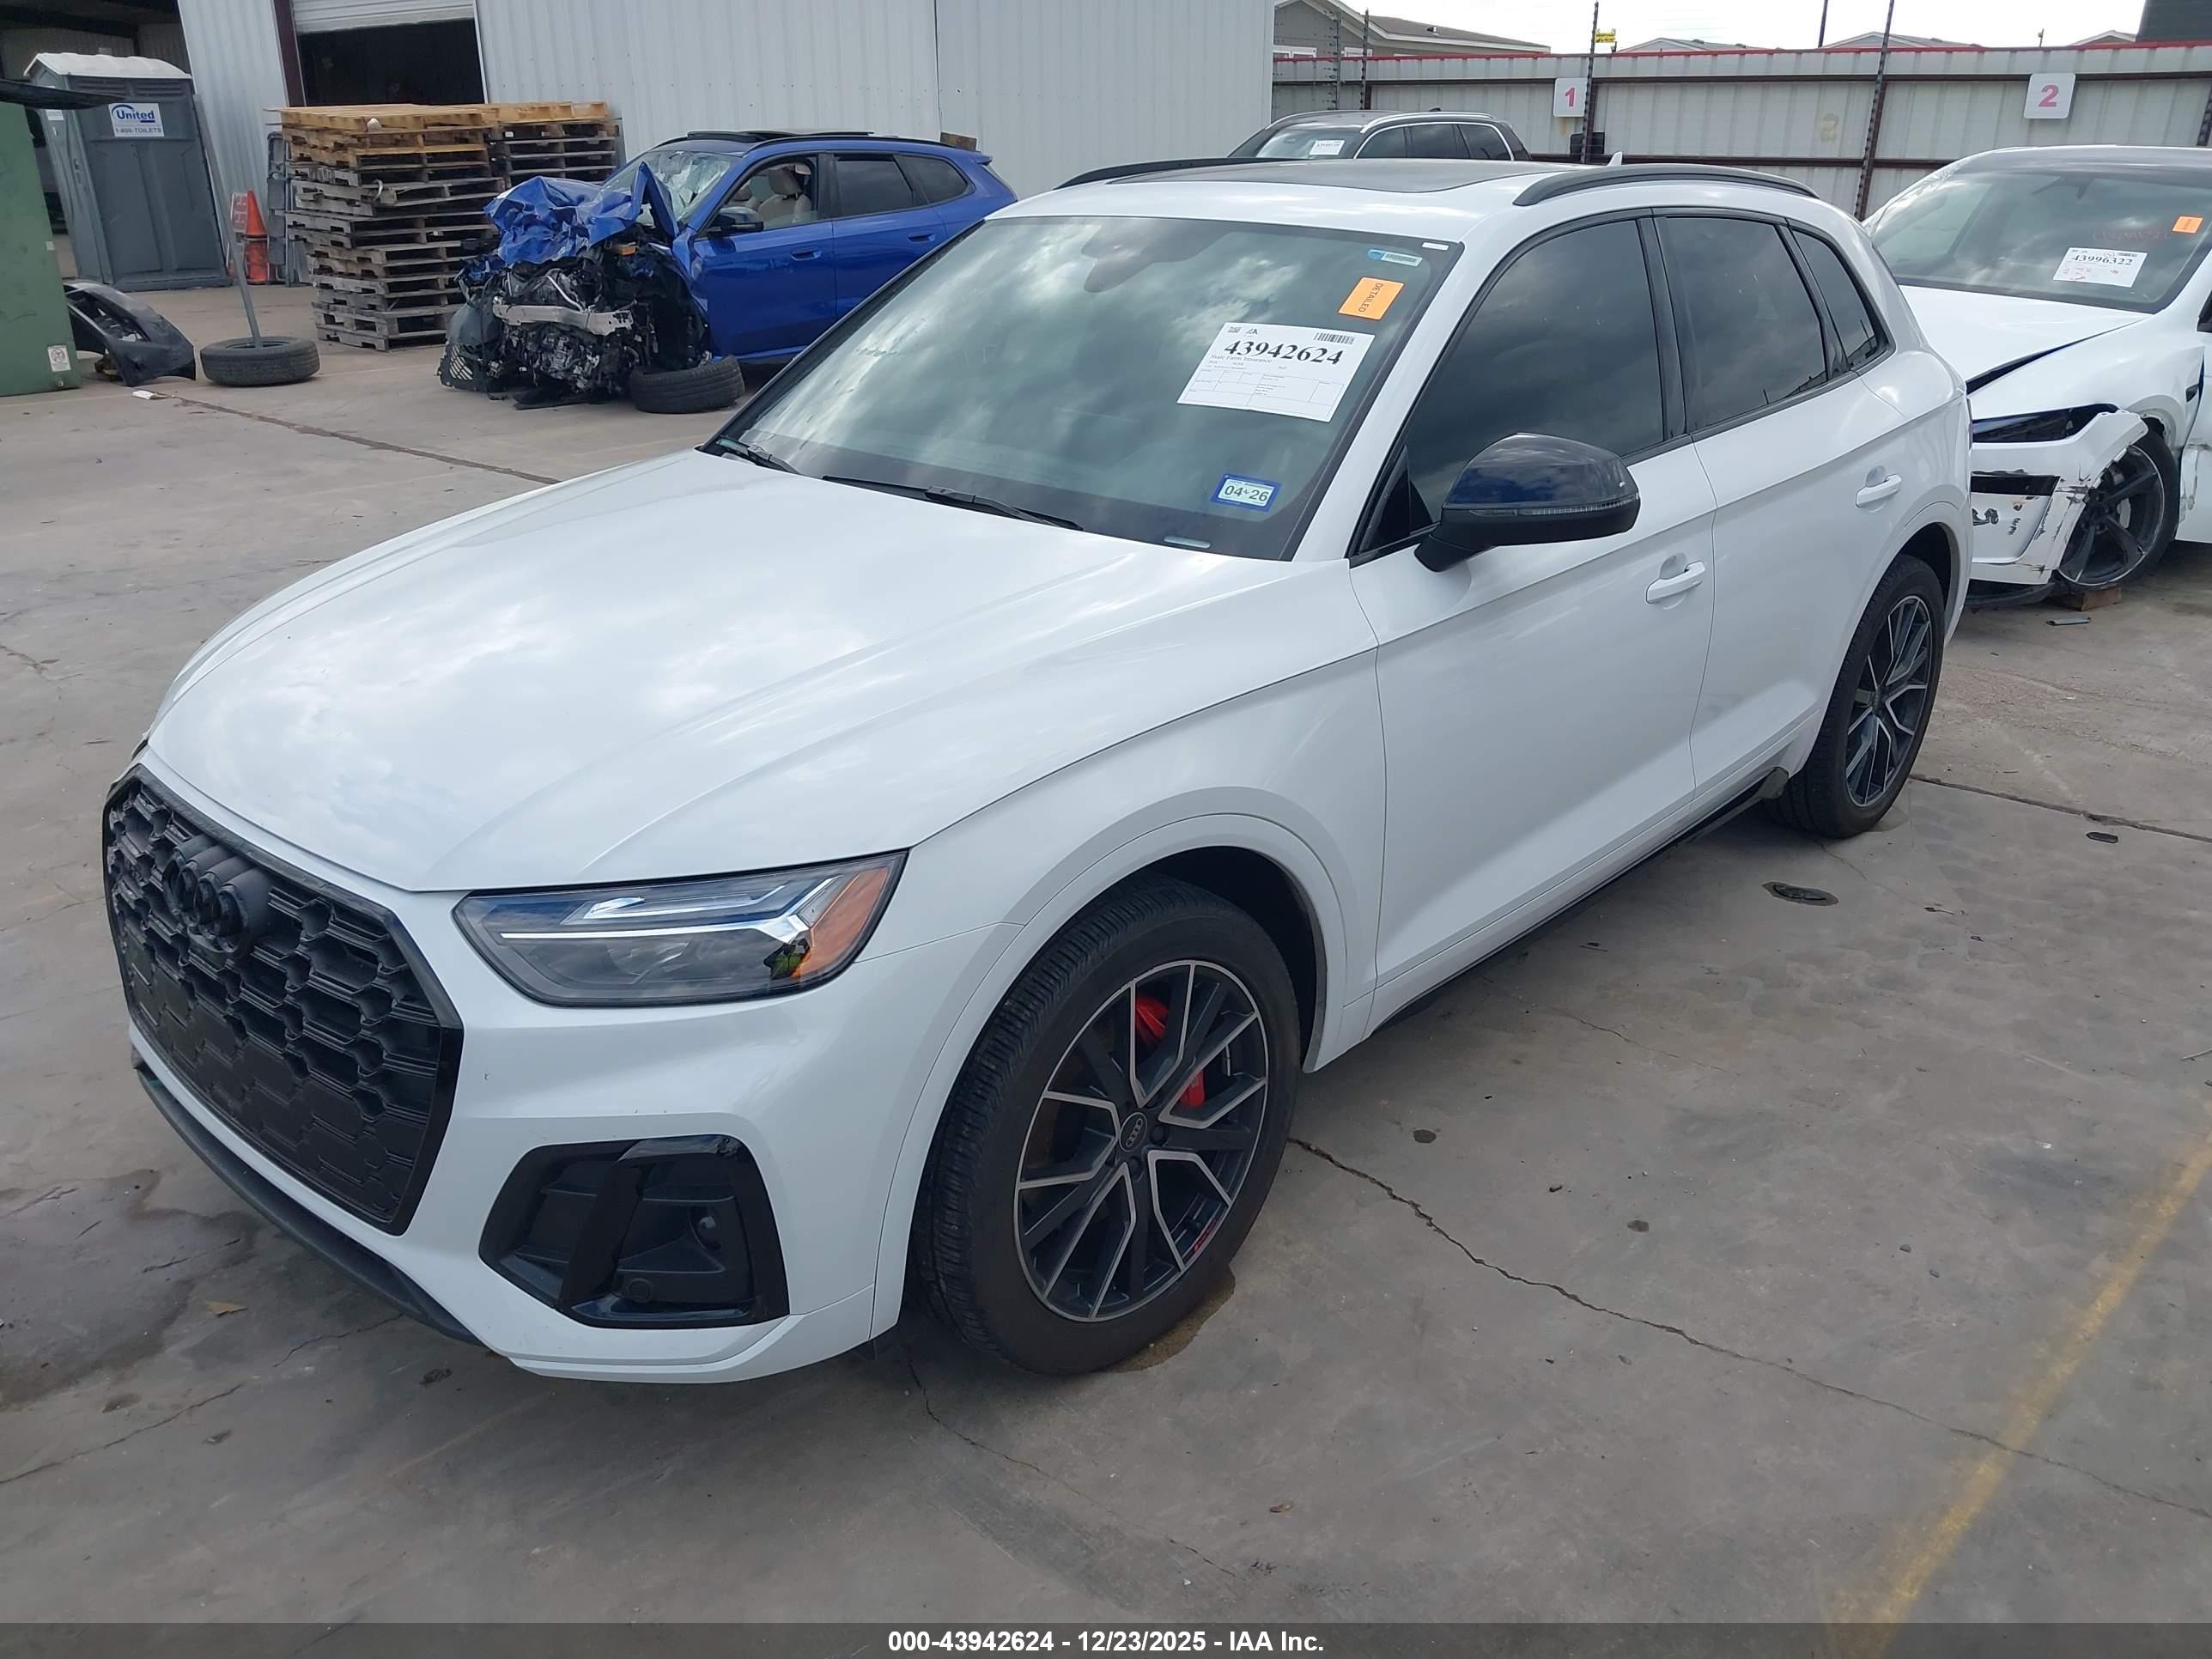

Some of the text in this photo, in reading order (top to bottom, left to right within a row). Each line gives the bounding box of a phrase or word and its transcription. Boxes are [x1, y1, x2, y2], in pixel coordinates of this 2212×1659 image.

[1565, 87, 1576, 107] 1
[2038, 84, 2059, 107] 2
[116, 110, 155, 119] United
[2071, 254, 2134, 266] 43996322
[1358, 283, 1384, 313] DETAILED
[1224, 340, 1344, 364] 43942624
[1224, 485, 1269, 501] 04 26
